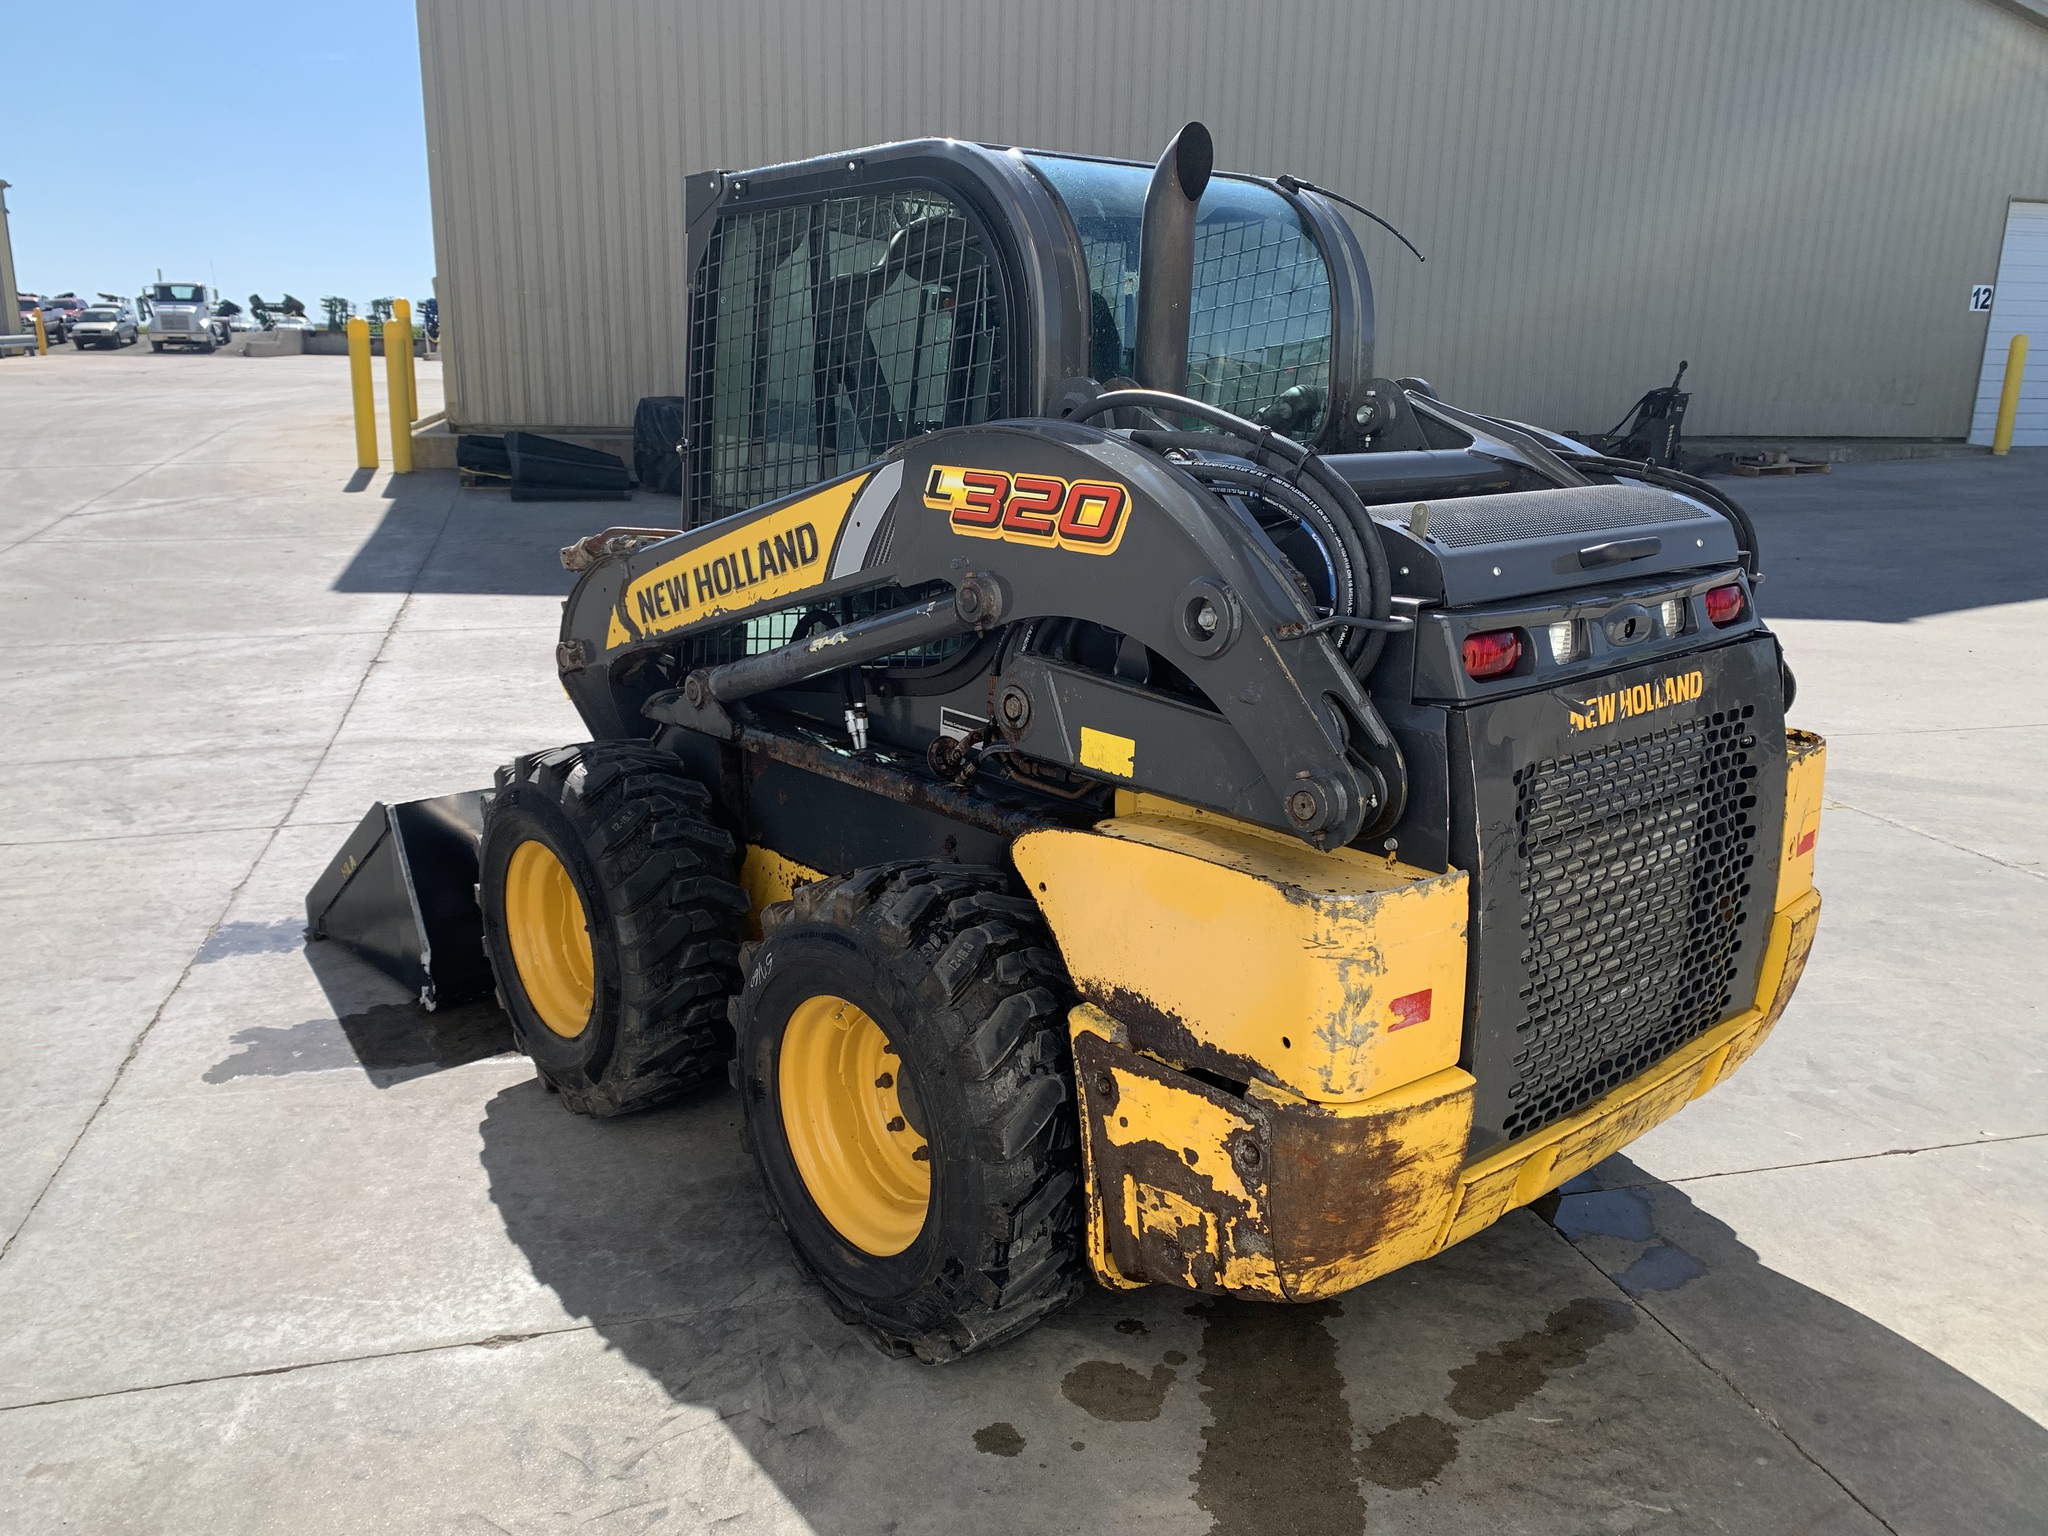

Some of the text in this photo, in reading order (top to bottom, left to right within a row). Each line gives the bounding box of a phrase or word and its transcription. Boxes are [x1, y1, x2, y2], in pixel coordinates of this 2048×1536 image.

[1973, 287, 1992, 310] 12
[924, 467, 1128, 548] L320
[636, 521, 820, 624] NEW HOLLAND
